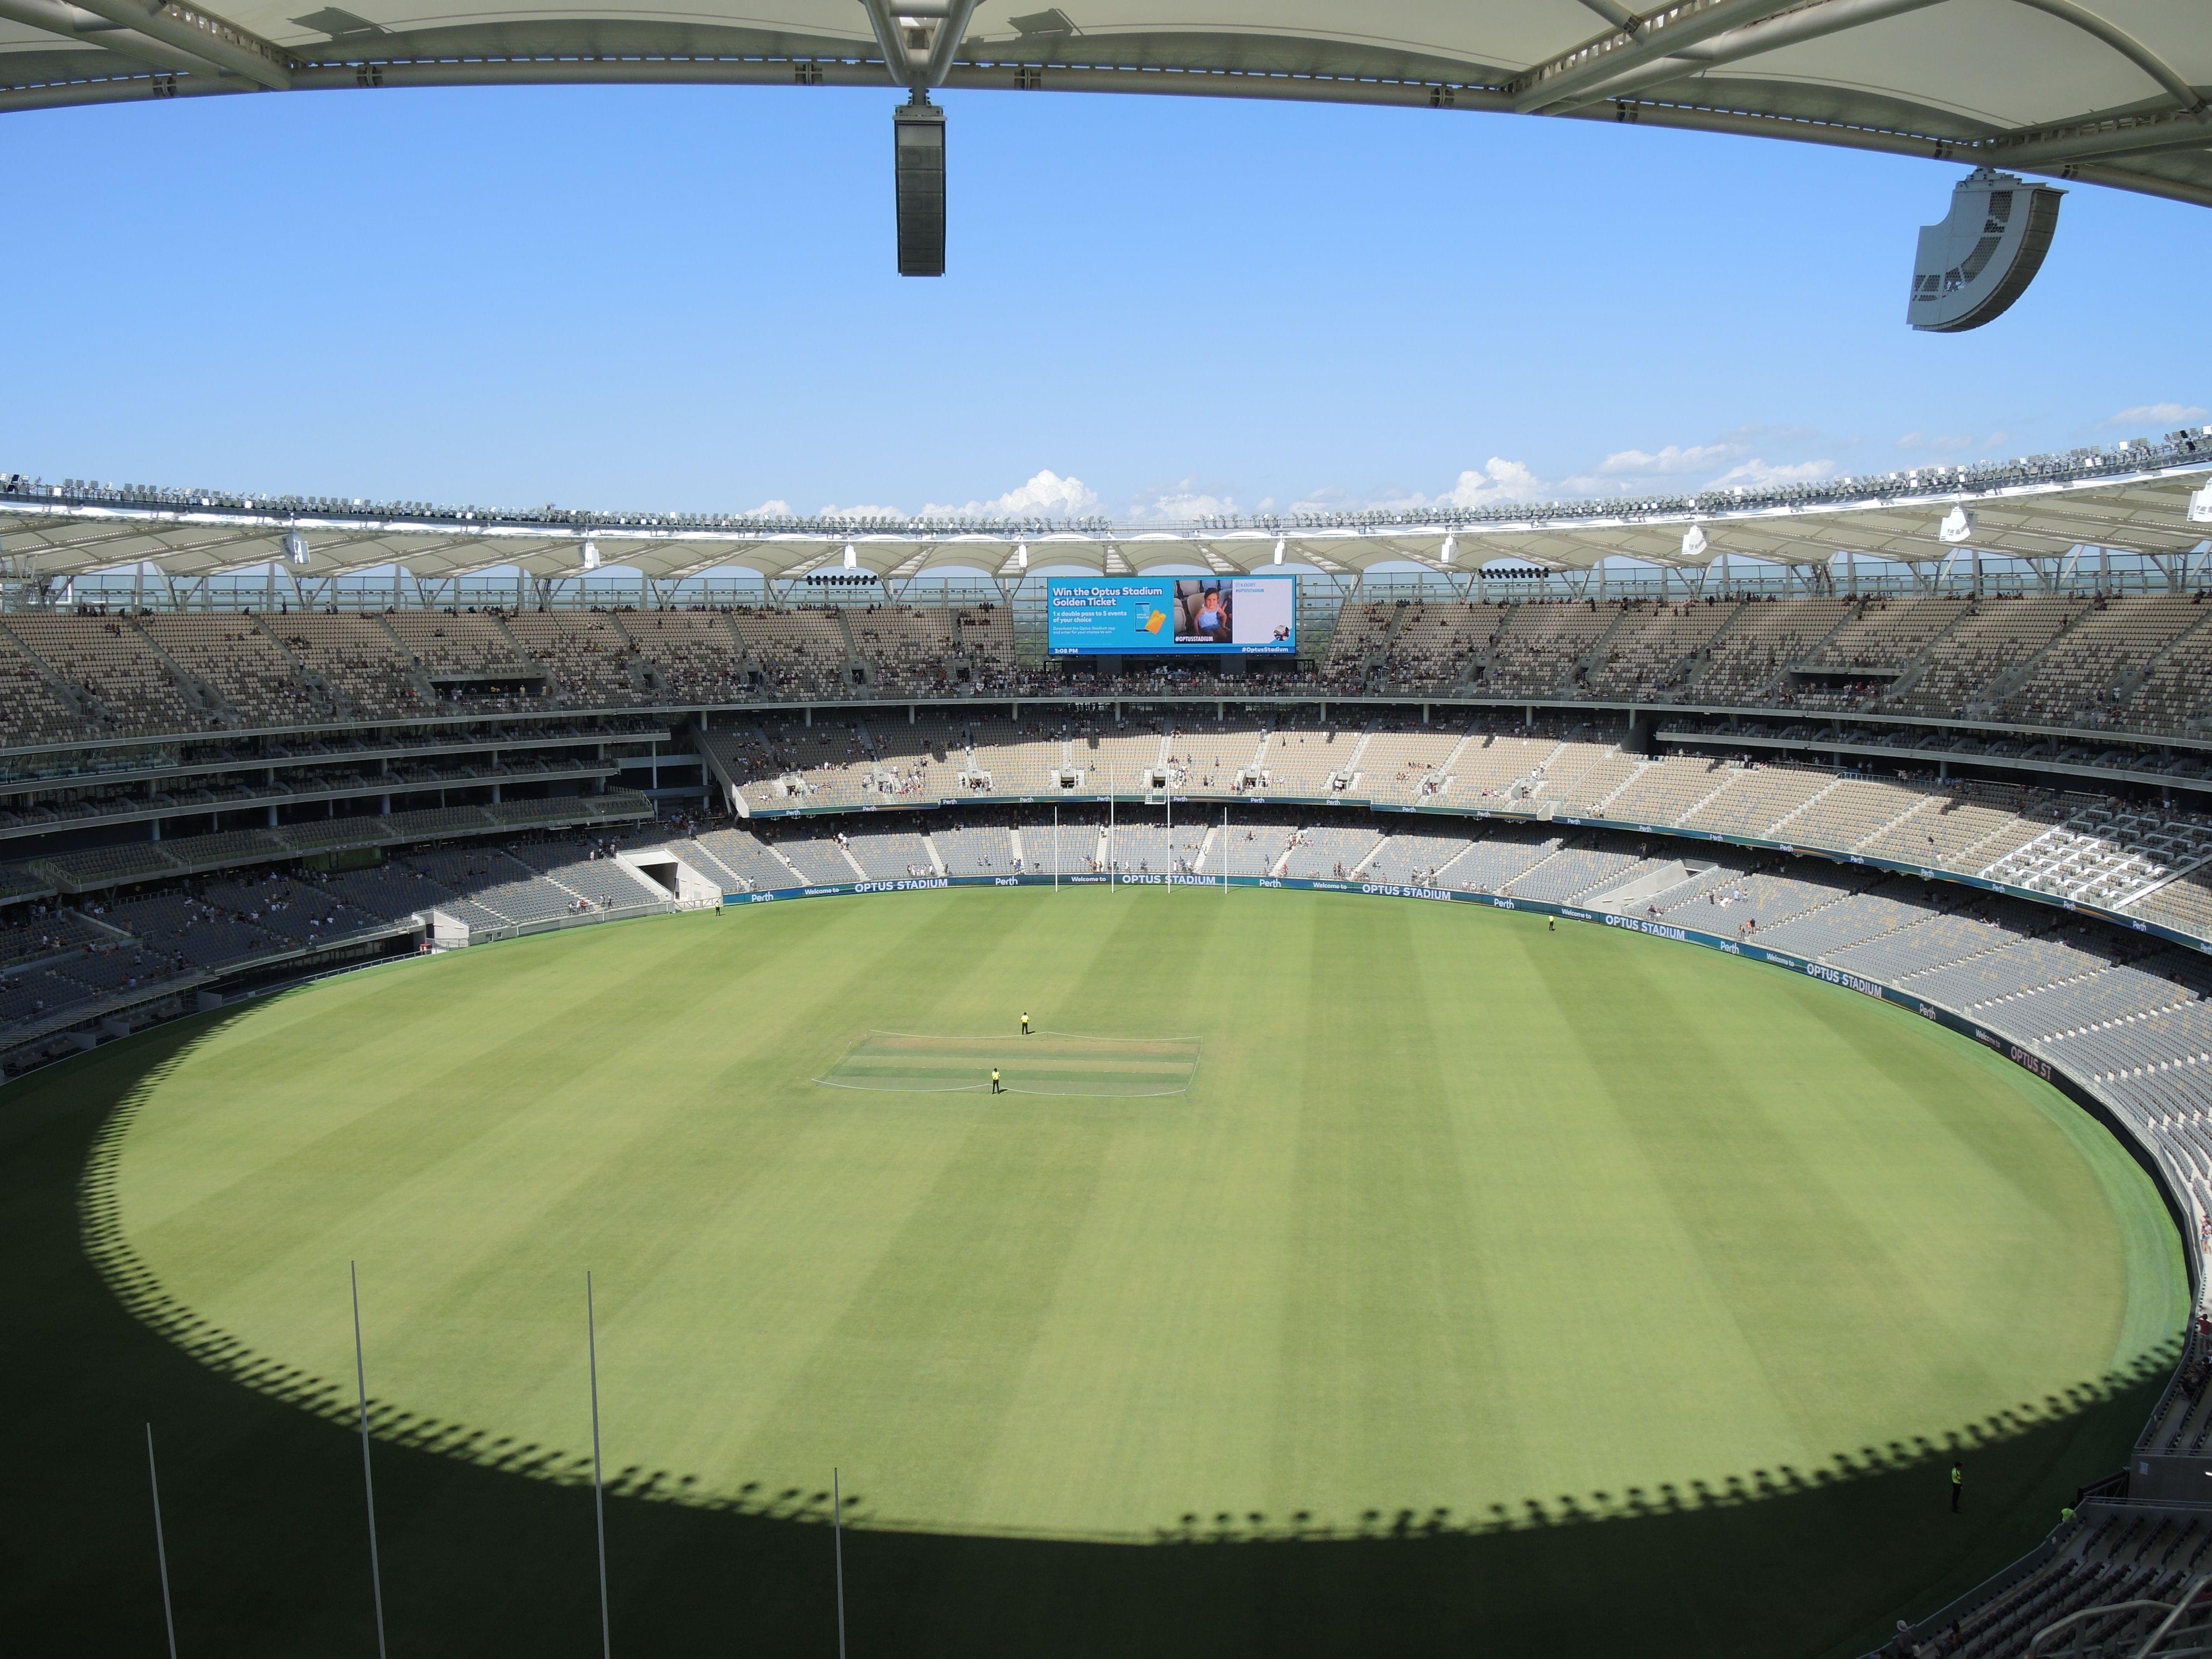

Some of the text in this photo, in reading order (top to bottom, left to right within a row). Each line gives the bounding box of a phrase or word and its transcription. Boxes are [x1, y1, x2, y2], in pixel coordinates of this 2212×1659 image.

[1053, 587, 1162, 597] Win the Optus Stadium
[1053, 597, 1117, 606] Golden Ticket
[1850, 855, 1864, 864] Perth
[1921, 868, 1934, 877] Perth
[854, 881, 894, 893] OPTUS
[897, 878, 948, 890] STADIUM
[995, 876, 1018, 886] Perth
[1122, 875, 1161, 884] OPTUS
[1165, 875, 1216, 885] STADIUM
[1259, 878, 1281, 888] Perth
[1362, 884, 1400, 896] OPTUS
[1402, 886, 1451, 900] STADIUM
[1992, 884, 2005, 893] Perth
[752, 891, 774, 902] Perth
[1494, 898, 1514, 910] Perth
[2063, 900, 2076, 911] Perth
[1562, 908, 1584, 918] Welcome
[1605, 915, 1639, 930] OPTUS
[1641, 921, 1685, 940] STADIUM
[2132, 920, 2147, 932] Perth
[1720, 941, 1739, 954] Perth
[1766, 952, 1788, 965] Welcome
[1807, 963, 1840, 983] OPTUS
[1842, 974, 1882, 998] STADIUM
[1919, 1003, 1936, 1020] Perth
[1975, 1028, 1995, 1045] Welcome
[2011, 1046, 2038, 1072] OPTUS
